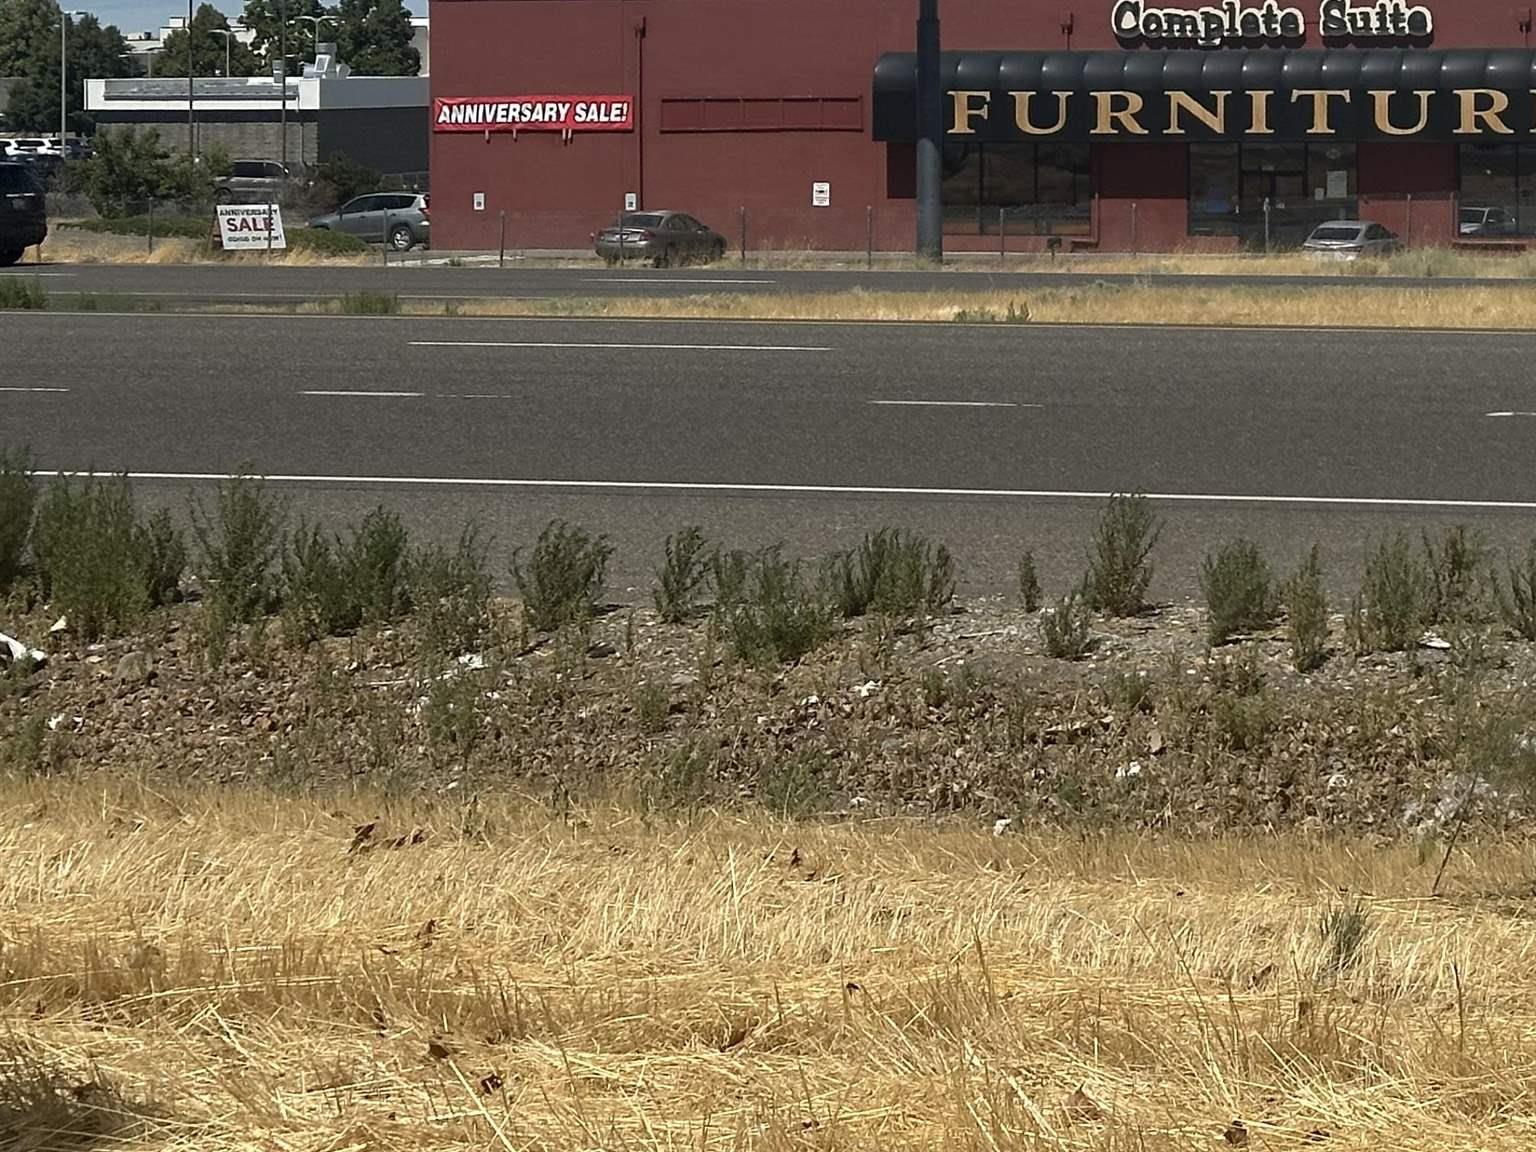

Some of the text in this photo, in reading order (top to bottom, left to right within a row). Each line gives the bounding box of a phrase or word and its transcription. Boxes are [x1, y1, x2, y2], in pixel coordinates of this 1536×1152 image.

[438, 102, 628, 125] ANNIVERSARY SALE!
[219, 208, 278, 217] ANNIVERSAY
[226, 217, 275, 232] SALE
